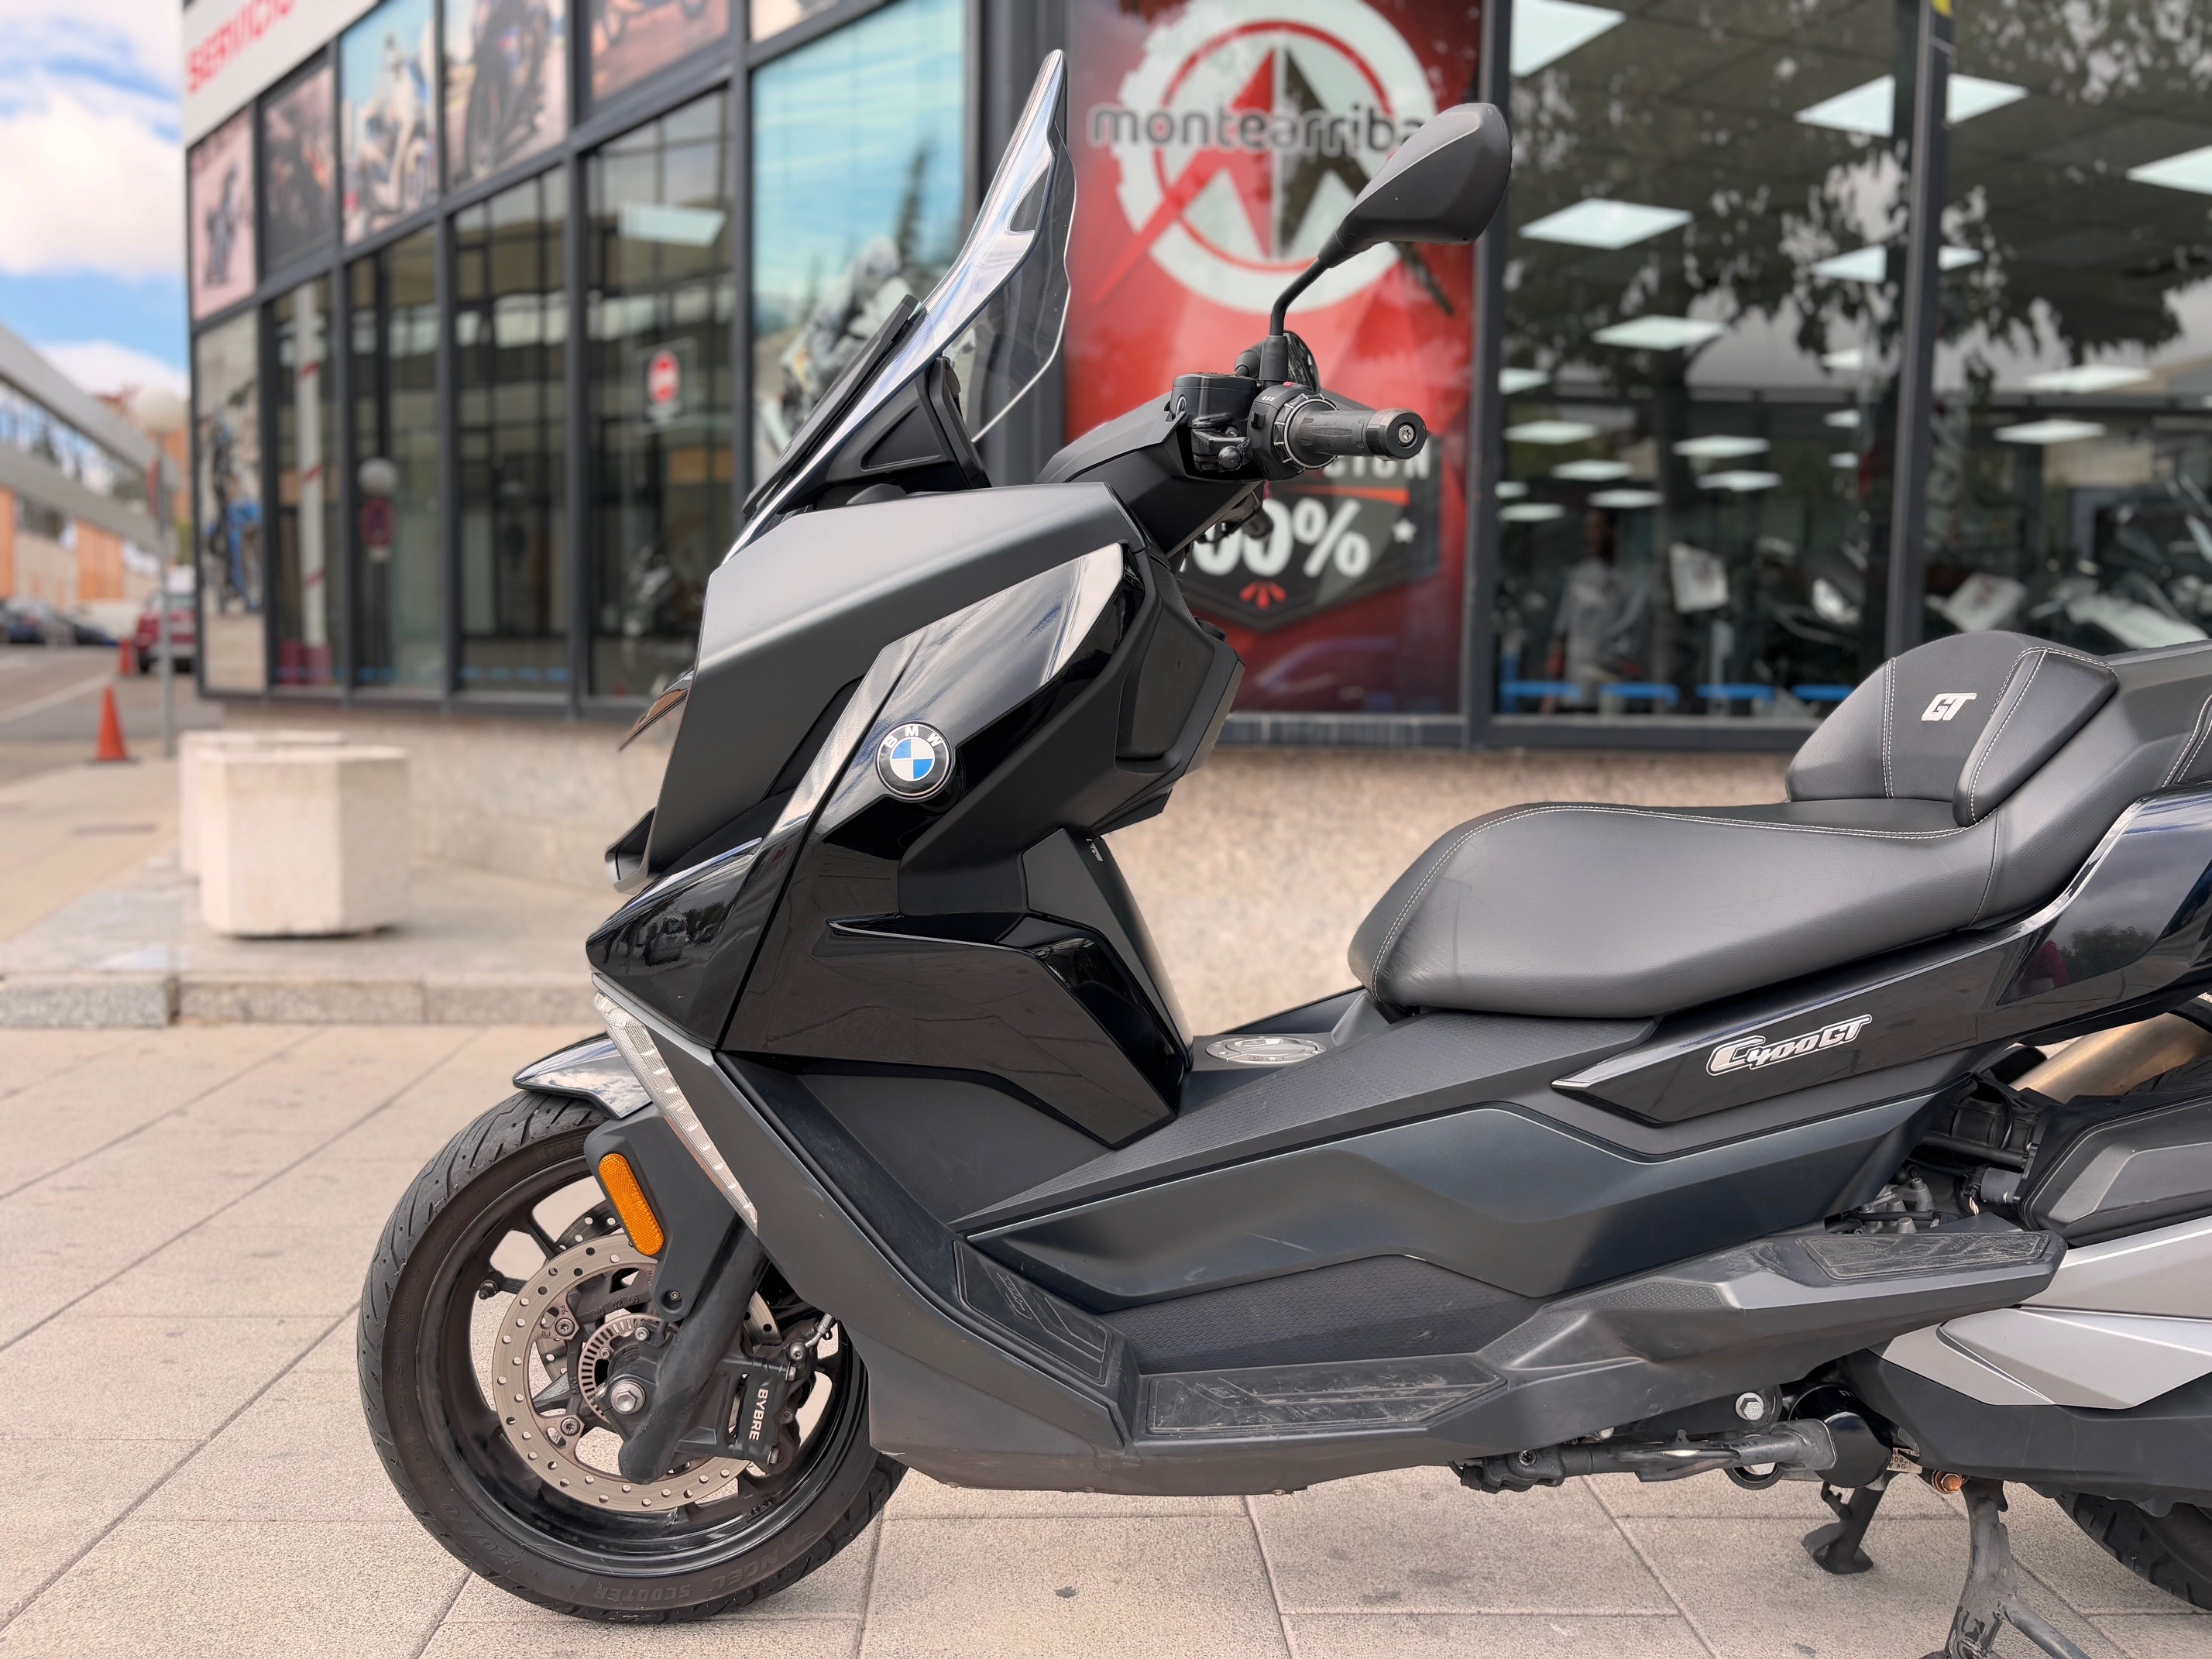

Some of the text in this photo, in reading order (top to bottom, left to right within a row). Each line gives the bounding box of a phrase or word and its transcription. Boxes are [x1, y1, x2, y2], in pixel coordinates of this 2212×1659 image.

[1180, 497, 1370, 578] 00%
[1922, 693, 1977, 721] GT
[883, 725, 943, 749] BMW
[749, 1389, 768, 1441] BYBRE
[593, 1583, 692, 1602] SCOOTER
